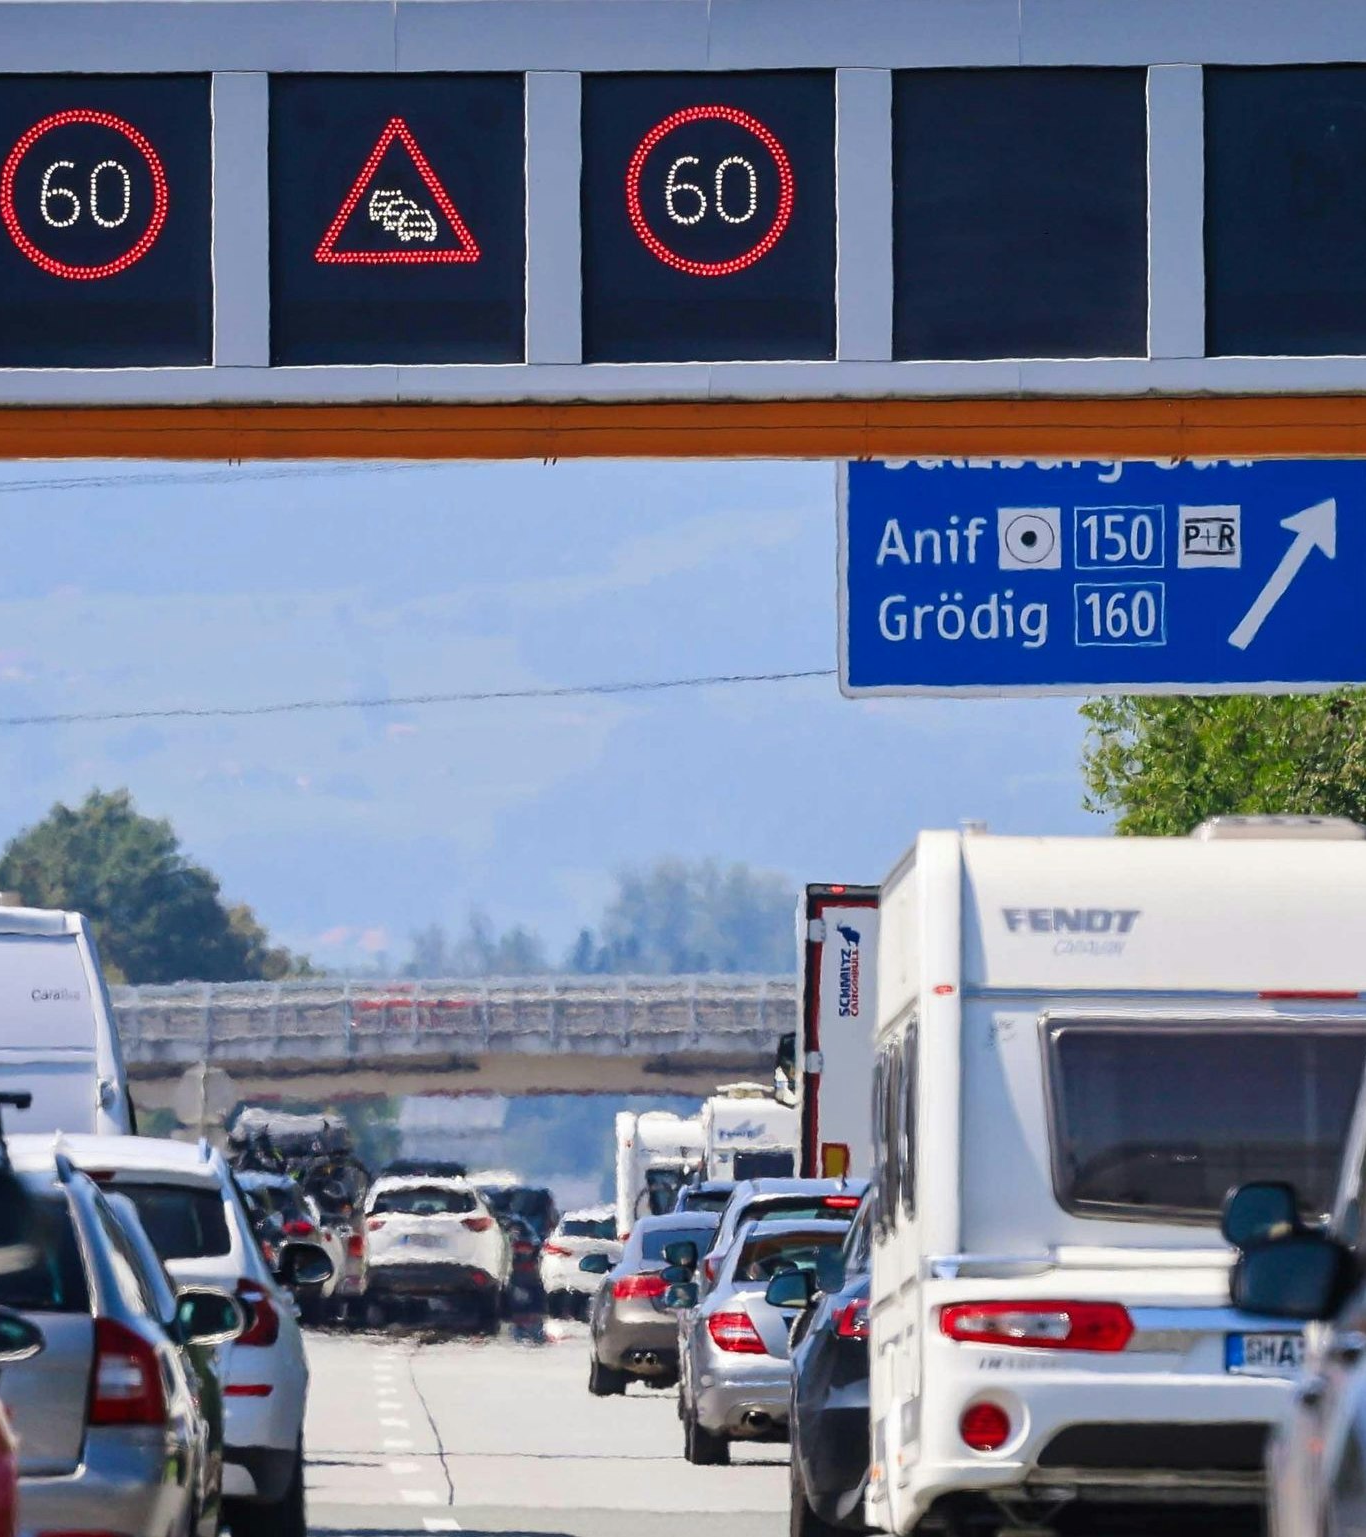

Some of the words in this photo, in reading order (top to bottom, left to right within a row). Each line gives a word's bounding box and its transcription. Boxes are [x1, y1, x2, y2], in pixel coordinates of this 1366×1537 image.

[39, 159, 132, 230] 60
[664, 155, 758, 226] 60
[876, 516, 987, 566] Anif
[1081, 514, 1153, 562] 150
[1185, 524, 1235, 550] P+R
[878, 589, 1049, 649] Grödig
[1084, 591, 1156, 638] 160
[1001, 907, 1142, 933] FENDT
[839, 948, 851, 1017] SCHMITZ
